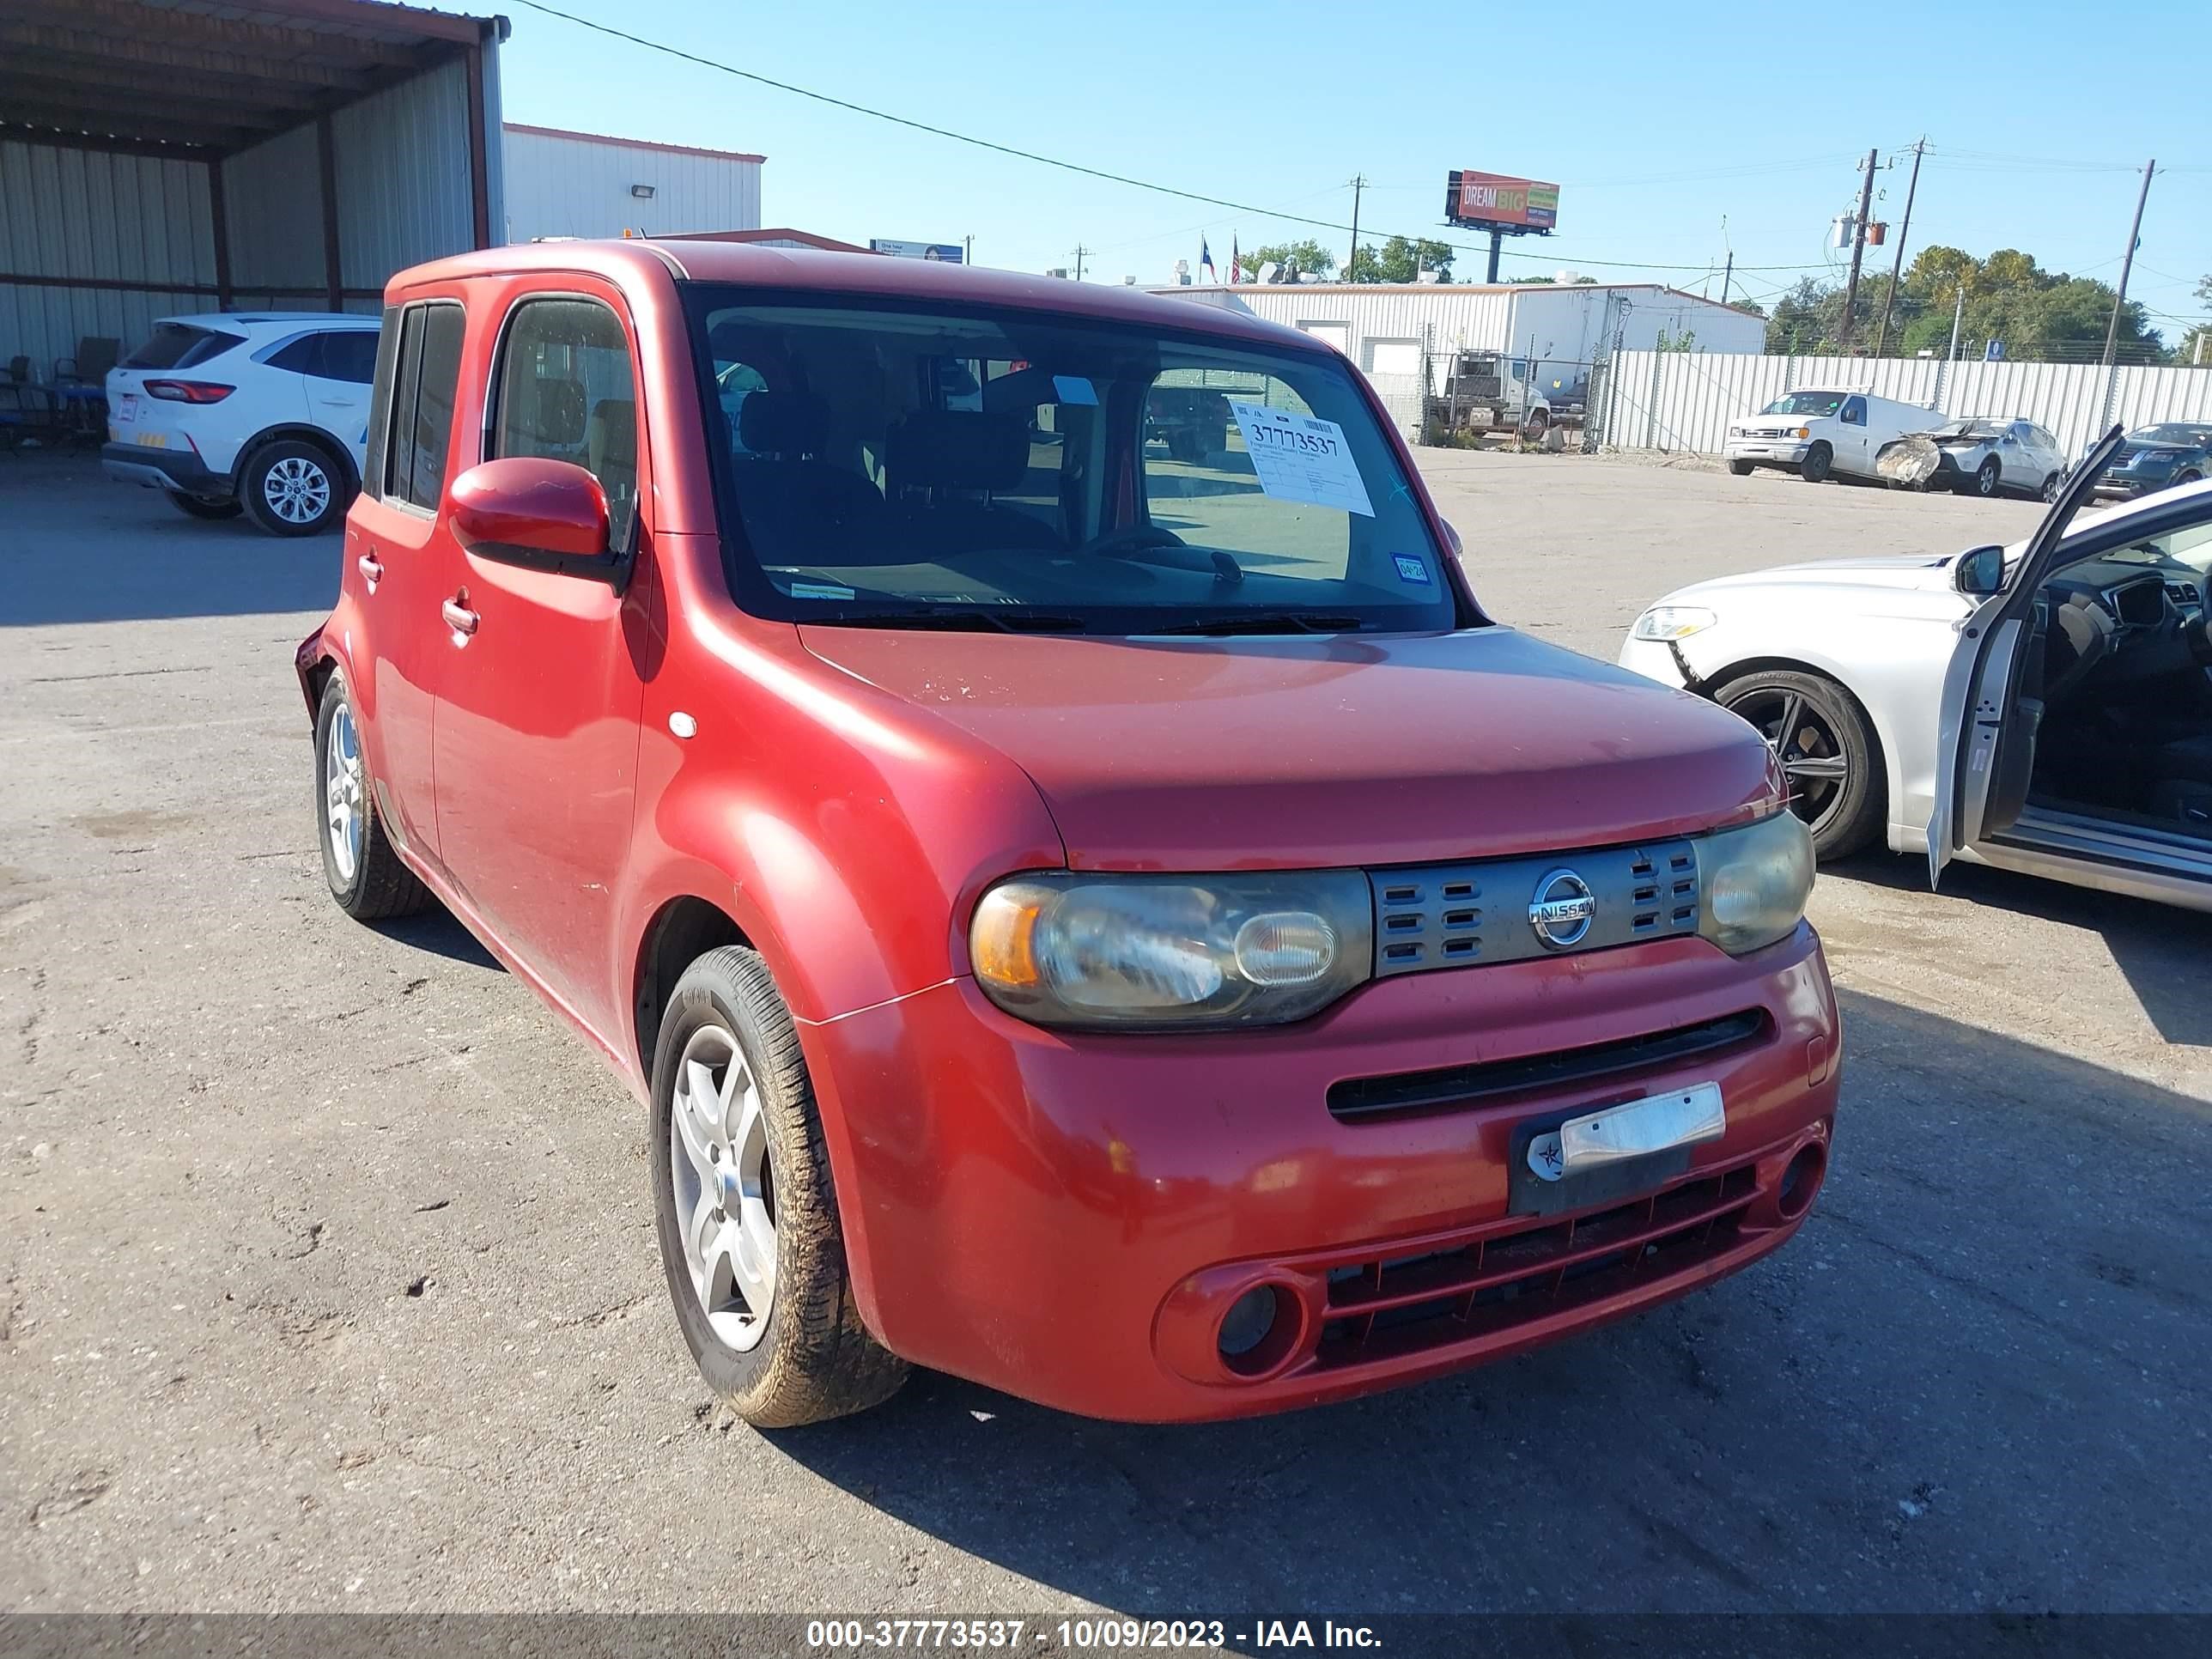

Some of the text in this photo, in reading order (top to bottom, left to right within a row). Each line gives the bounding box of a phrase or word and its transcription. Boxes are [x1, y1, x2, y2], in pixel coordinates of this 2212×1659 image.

[1464, 185, 1526, 212] DREAM BIG
[1250, 423, 1338, 457] 37773537
[1540, 901, 1595, 919] NISSAN
